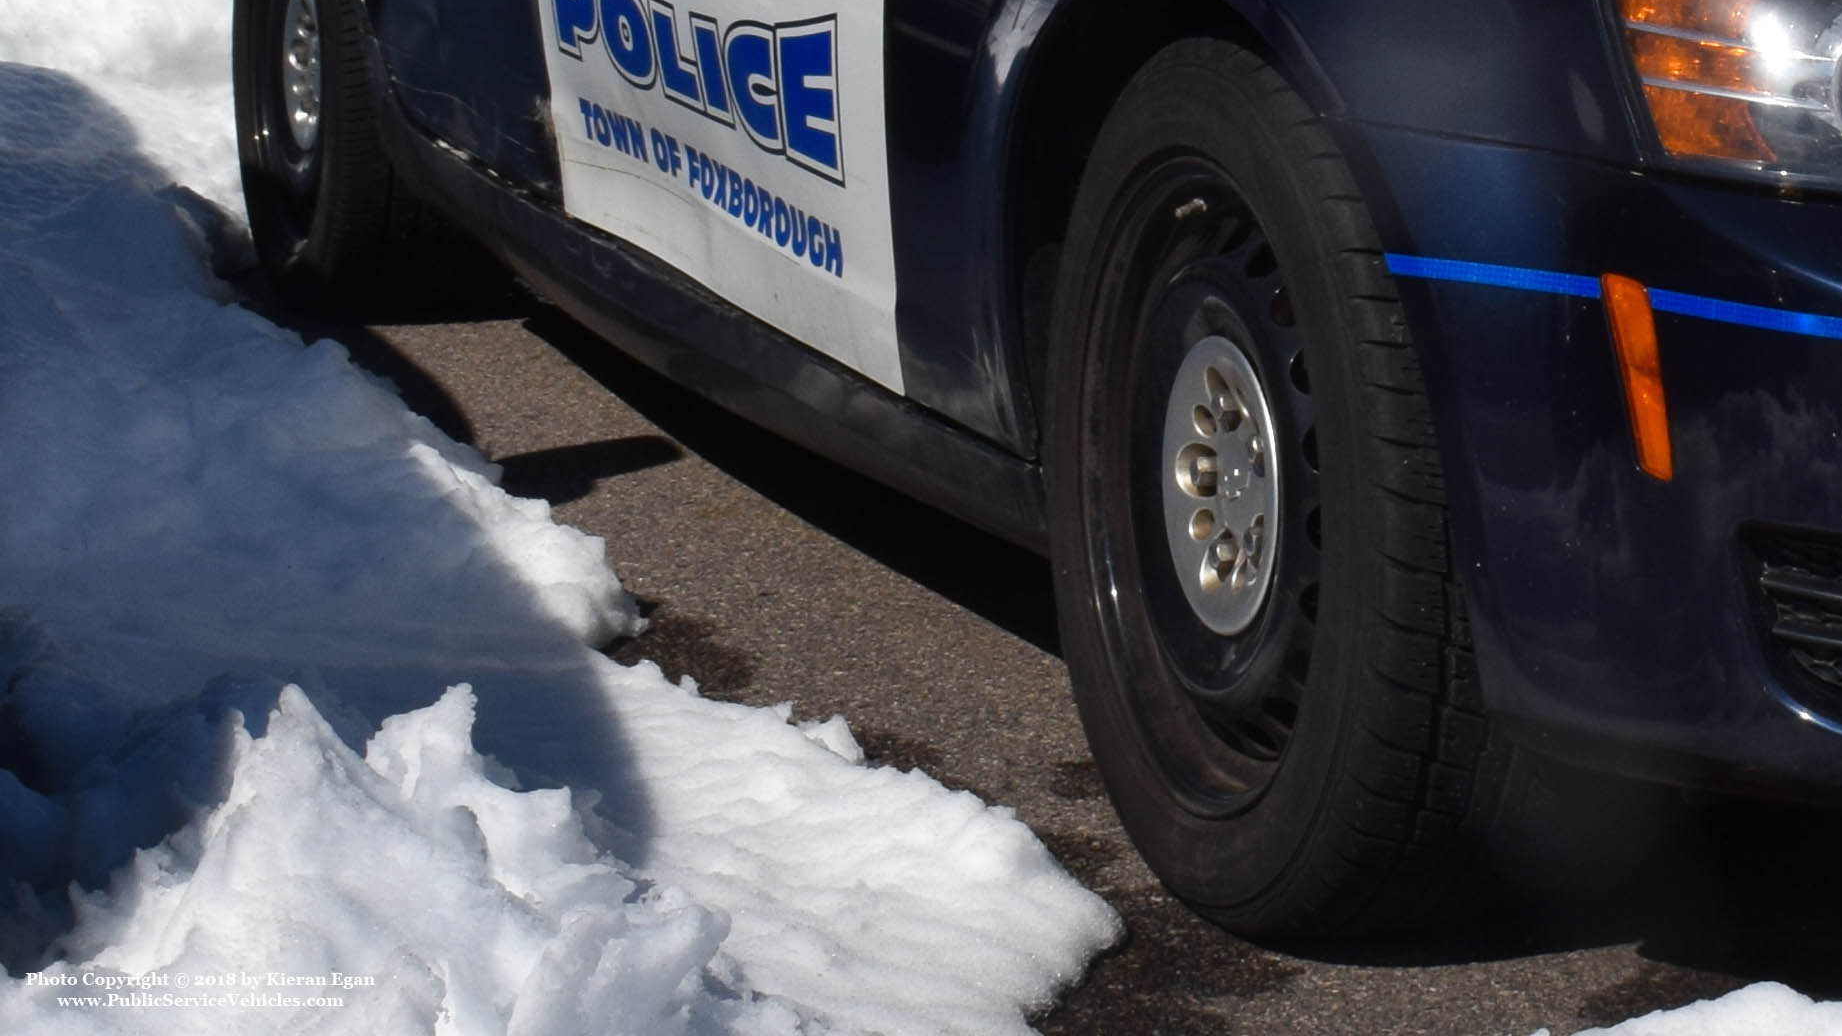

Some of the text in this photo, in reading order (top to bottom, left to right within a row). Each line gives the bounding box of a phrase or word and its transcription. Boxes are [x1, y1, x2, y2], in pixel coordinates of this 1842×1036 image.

[578, 97, 844, 278] TOWN OF FOXBOROUGH
